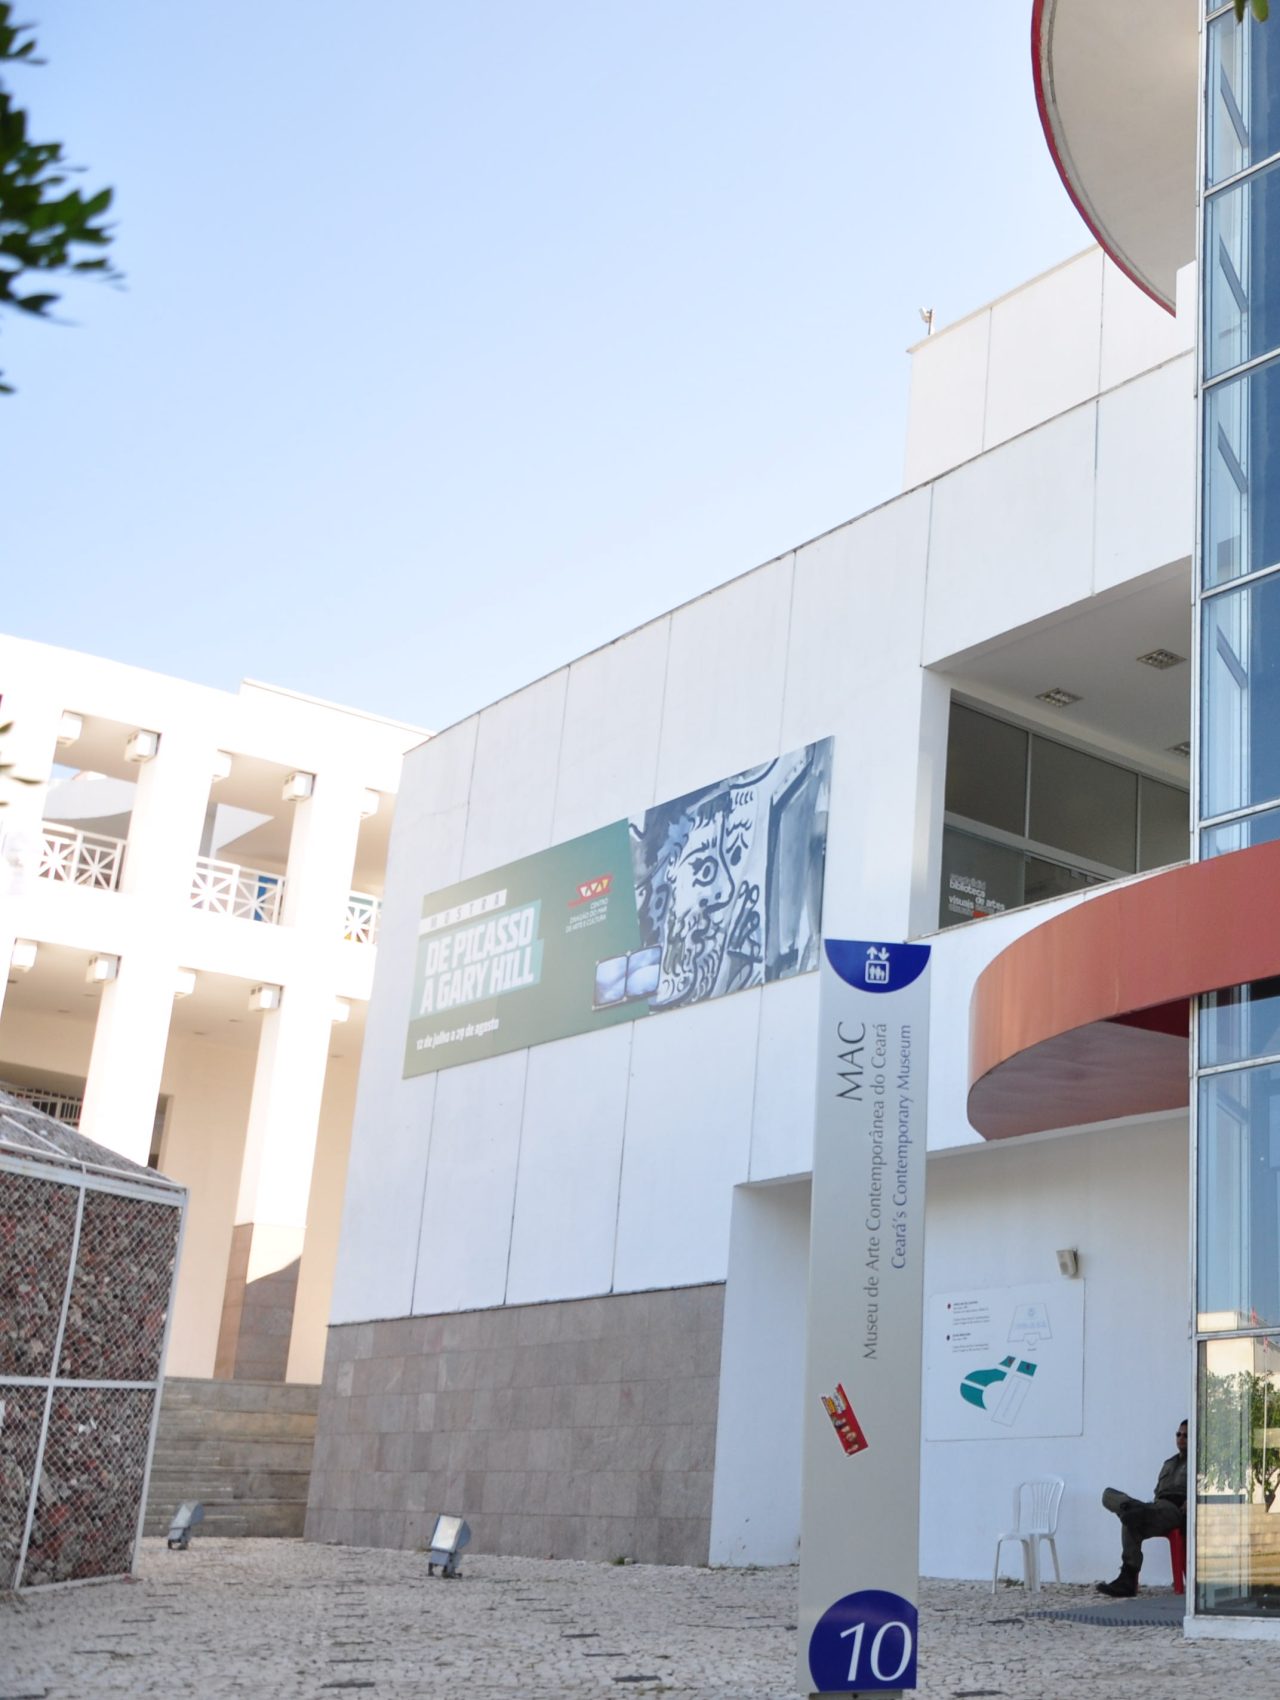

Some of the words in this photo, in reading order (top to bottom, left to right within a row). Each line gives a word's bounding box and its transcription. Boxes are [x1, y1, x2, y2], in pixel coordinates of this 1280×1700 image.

[424, 935, 452, 978] DE
[451, 907, 535, 970] PICASSO
[420, 977, 434, 1014] A
[435, 958, 490, 1010] GARY
[488, 945, 535, 995] HILL
[836, 1021, 866, 1102] MAC
[871, 1023, 887, 1069] Ceará
[897, 1025, 911, 1091] Museum
[869, 1073, 886, 1095] do
[865, 1100, 888, 1232] Contemporânea
[892, 1093, 914, 1206] Contemporary
[865, 1236, 880, 1271] Arte
[863, 1276, 879, 1298] de
[862, 1303, 879, 1360] Museu
[840, 1621, 912, 1682] 10
